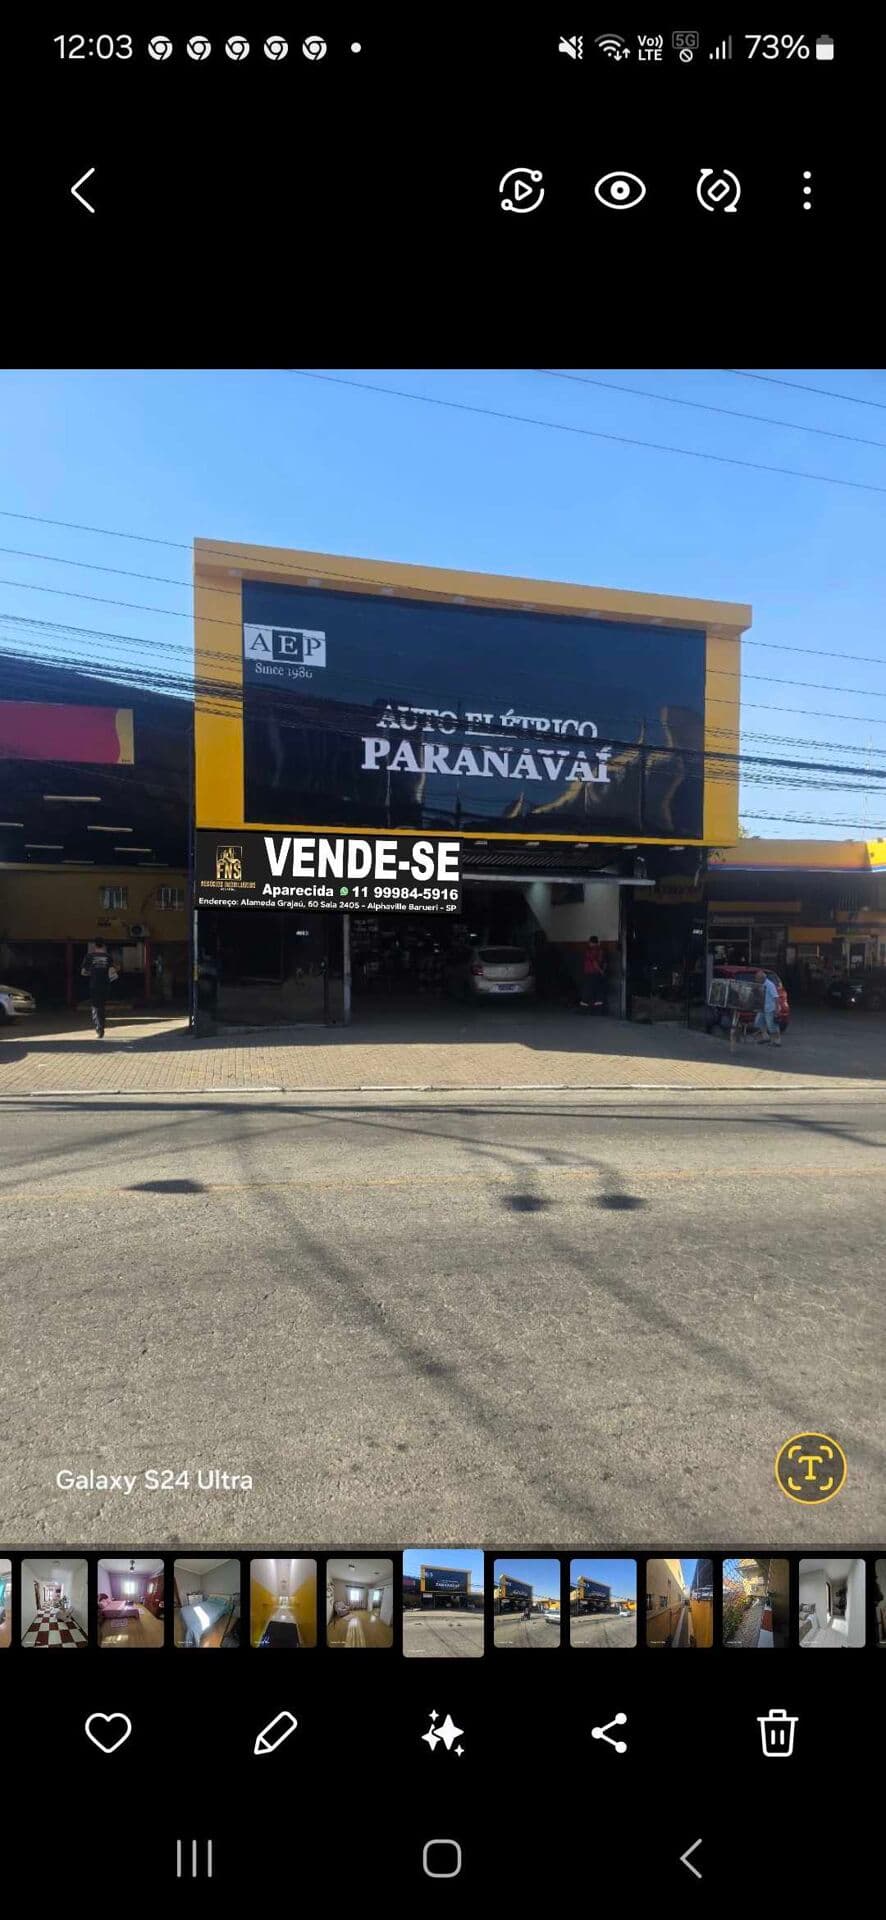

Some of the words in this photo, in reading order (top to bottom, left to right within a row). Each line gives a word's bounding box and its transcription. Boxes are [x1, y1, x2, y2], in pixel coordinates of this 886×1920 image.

[53, 34, 133, 60] 12:03
[675, 34, 696, 47] 5G
[745, 34, 810, 60] 73%
[638, 49, 663, 61] LTE
[249, 632, 322, 657] AEP
[255, 662, 285, 676] Since
[361, 736, 613, 784] PARANAVAÍ
